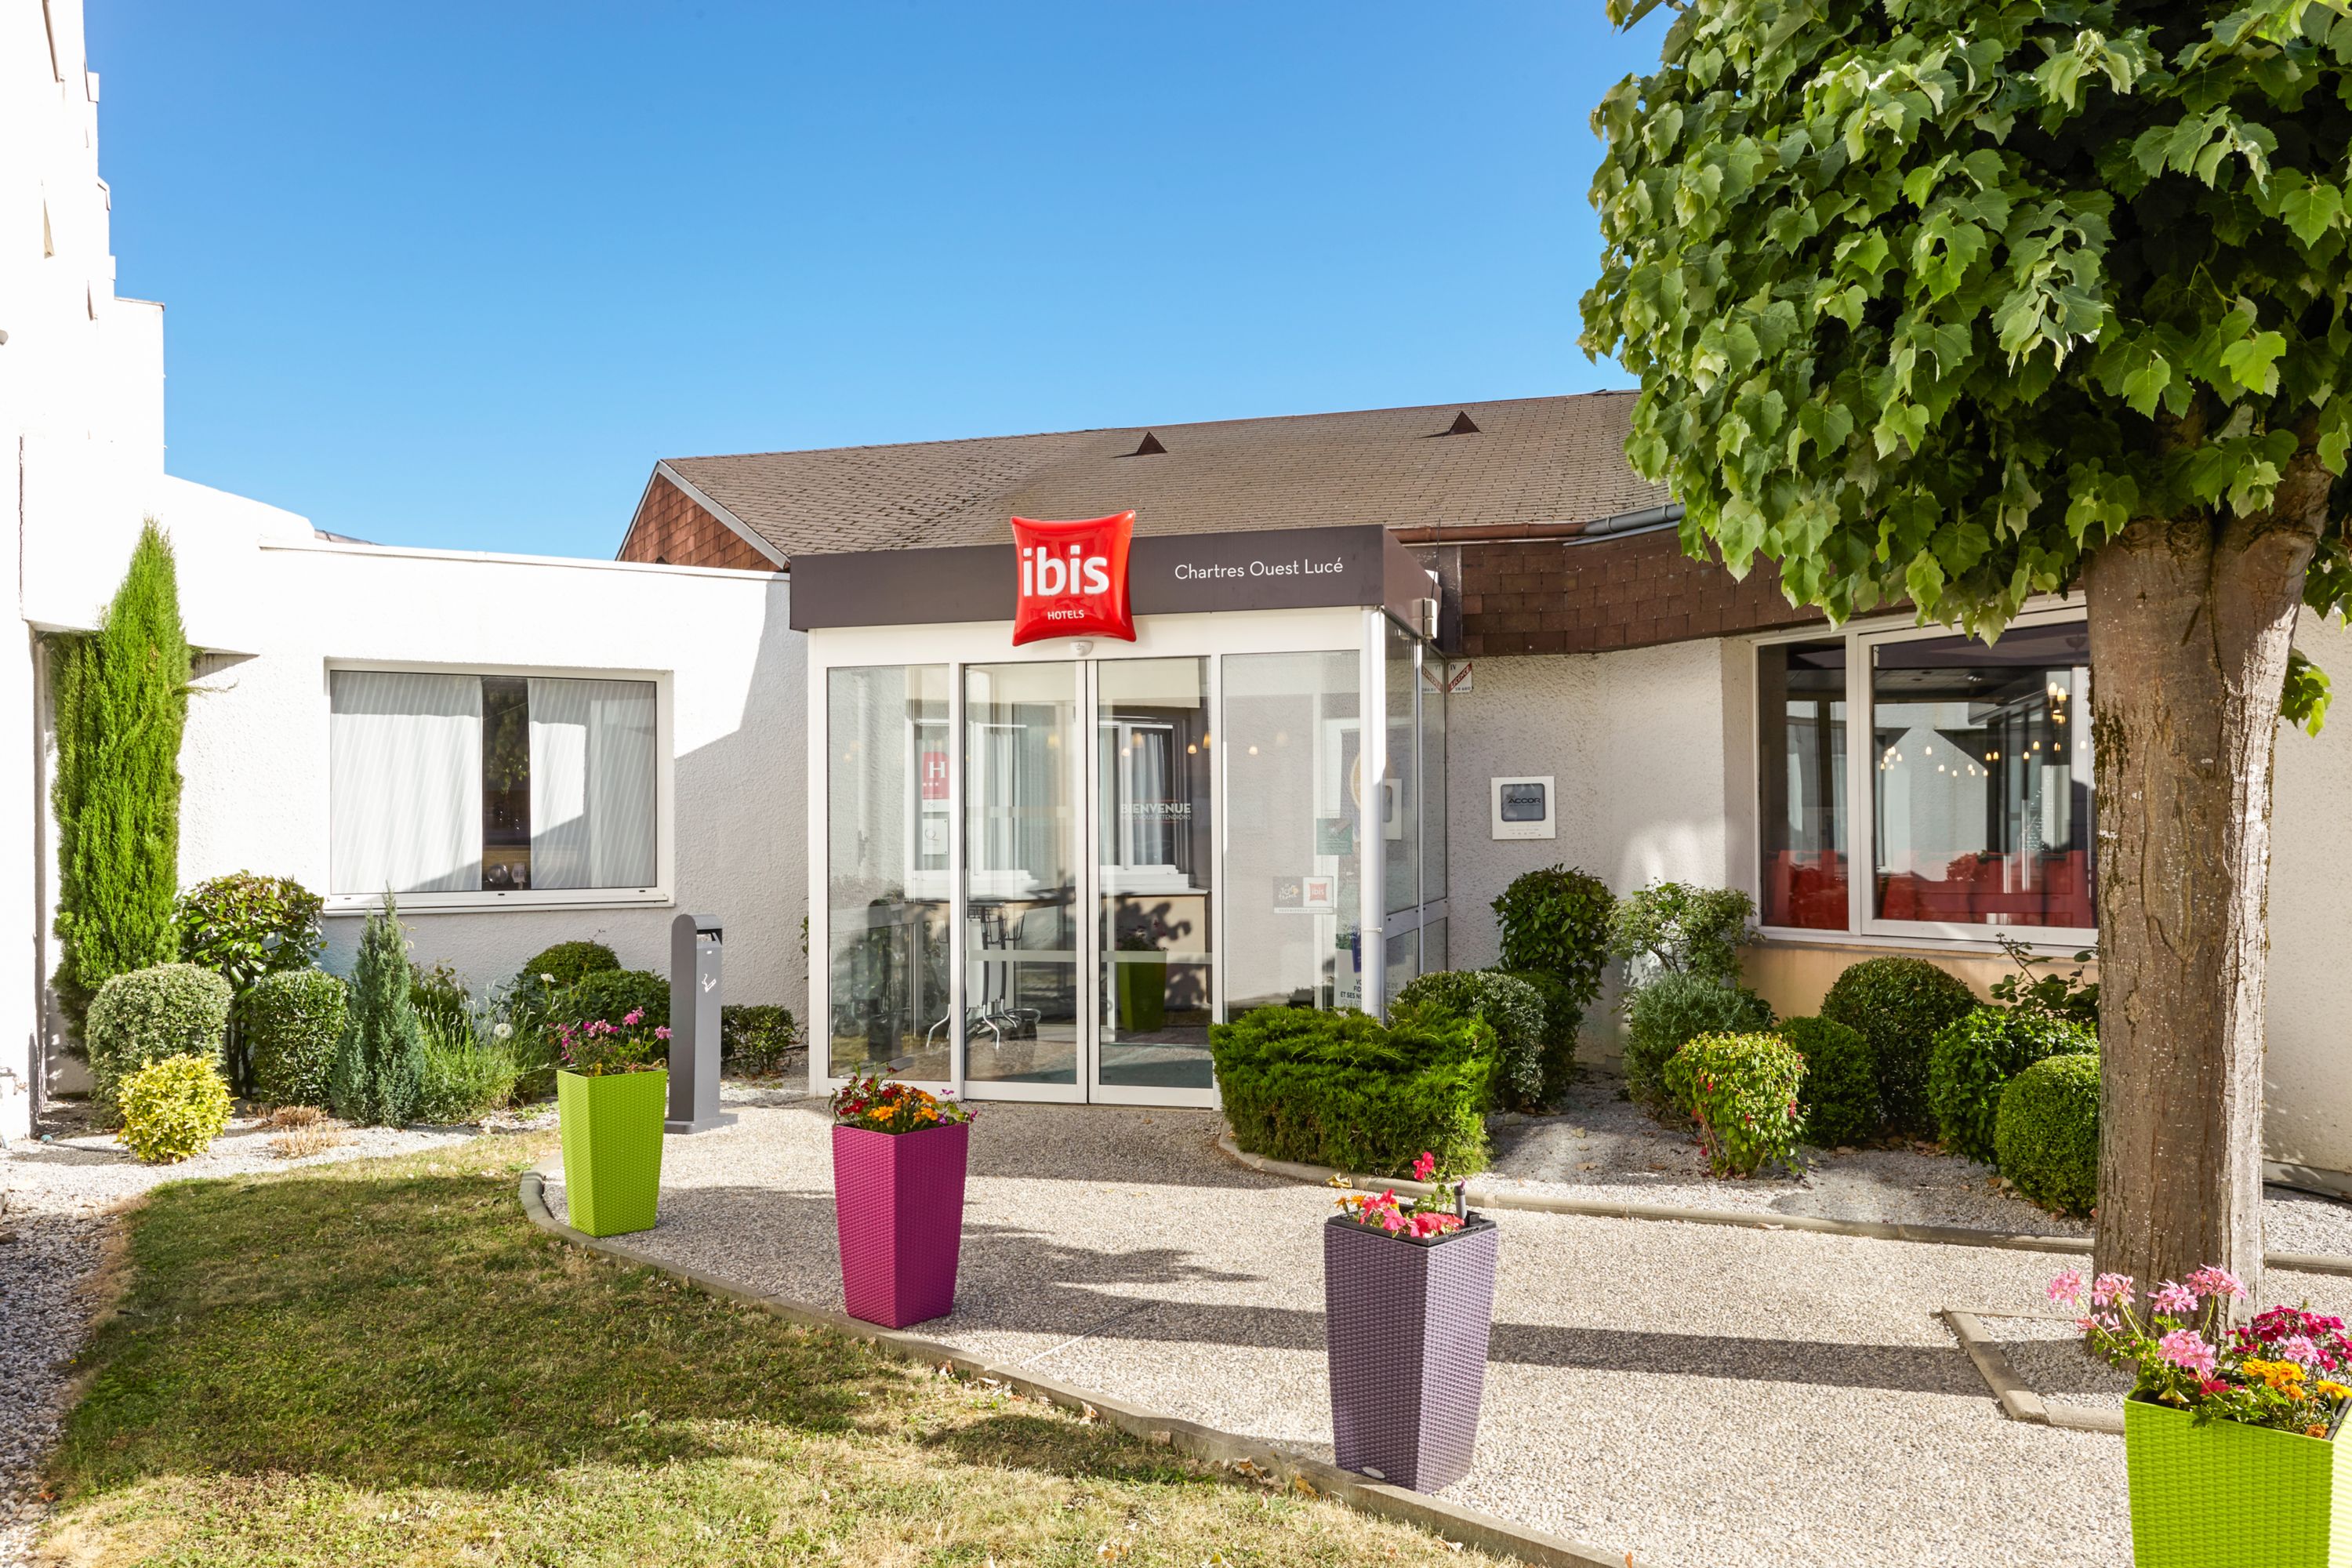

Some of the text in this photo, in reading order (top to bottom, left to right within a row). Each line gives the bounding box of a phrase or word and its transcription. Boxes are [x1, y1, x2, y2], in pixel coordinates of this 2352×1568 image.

[1022, 544, 1110, 597] ibis
[1174, 557, 1344, 580] Chartres Ouest Lucé
[1047, 609, 1085, 621] HOTELS
[1450, 665, 1471, 688] LICENCE
[928, 760, 947, 779] H
[1120, 803, 1192, 814] BIENVENUE
